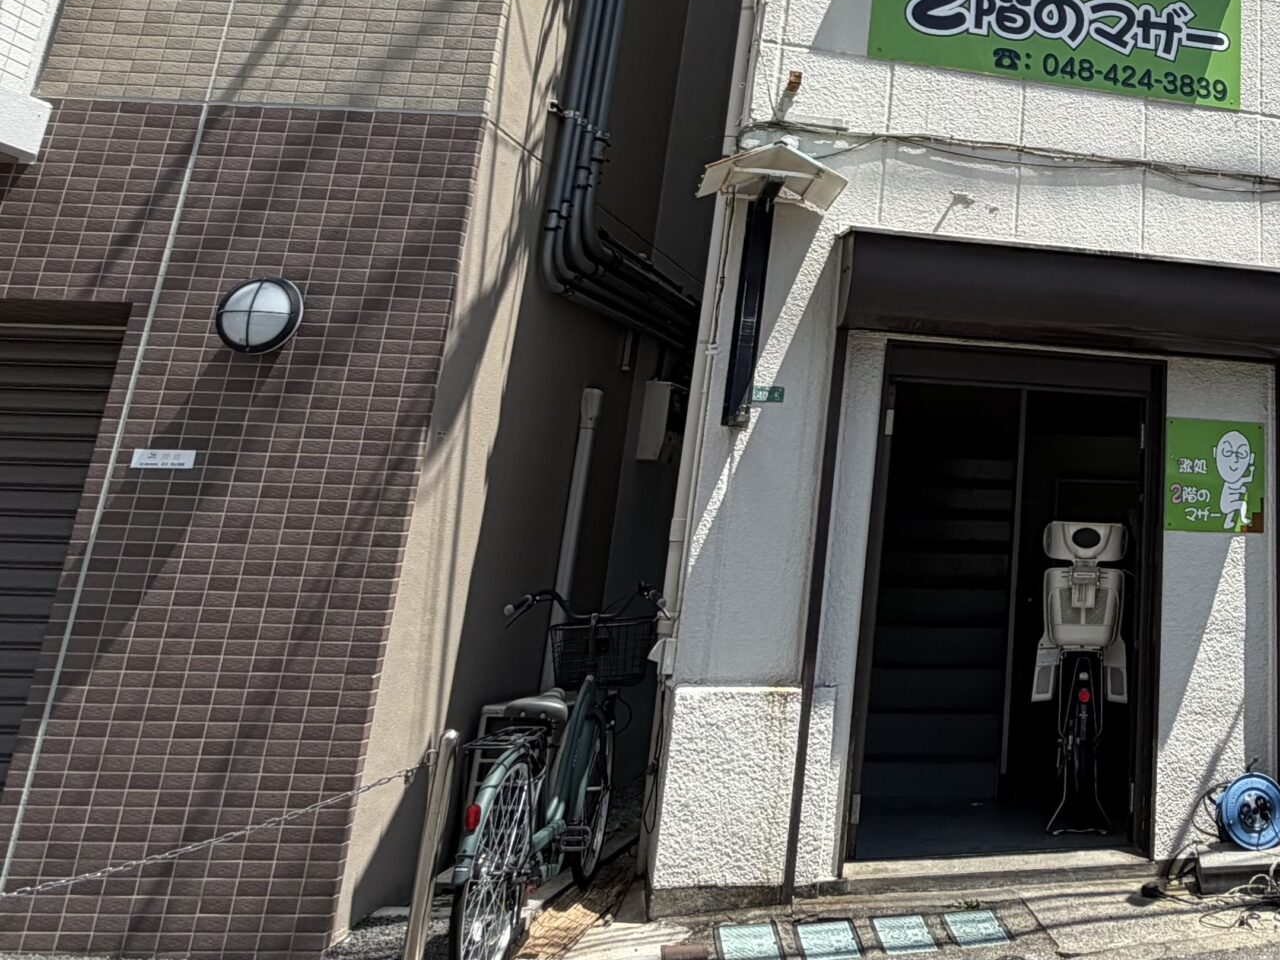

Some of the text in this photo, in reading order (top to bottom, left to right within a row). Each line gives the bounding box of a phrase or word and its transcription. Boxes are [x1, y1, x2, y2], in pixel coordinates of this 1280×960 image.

[1042, 53, 1228, 102] 048-424-3839
[1170, 483, 1211, 504] 2階の
[1185, 506, 1221, 521] マザー
